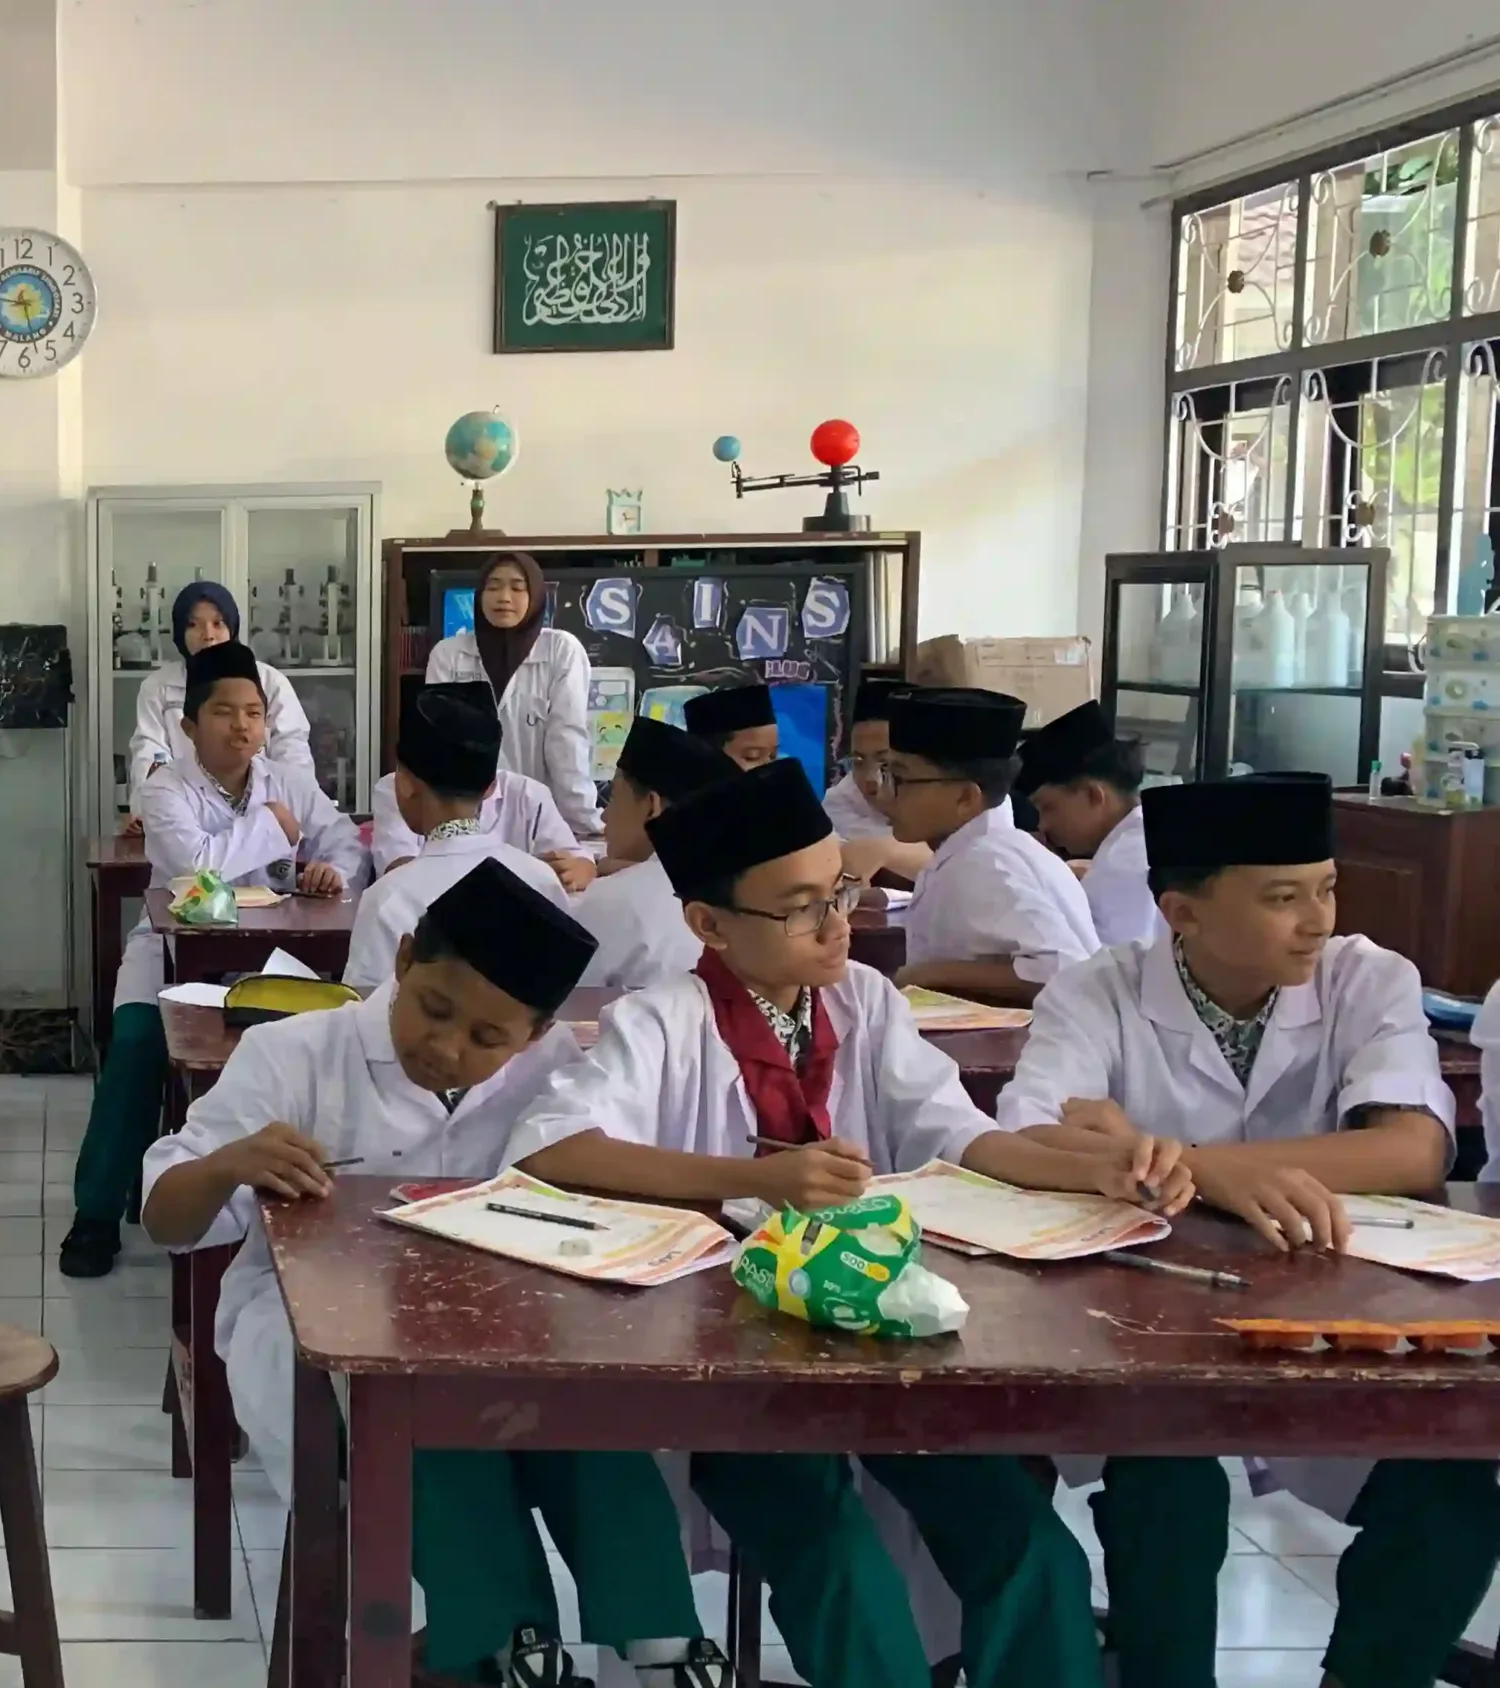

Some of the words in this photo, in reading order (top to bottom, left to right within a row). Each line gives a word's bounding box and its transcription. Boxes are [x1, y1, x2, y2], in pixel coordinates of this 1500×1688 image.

[14, 238, 33, 260] 12
[47, 245, 52, 267] 1
[63, 265, 76, 286] 2
[71, 292, 84, 314] 3
[62, 321, 75, 342] 4
[18, 346, 31, 369] 6
[44, 340, 57, 361] 5
